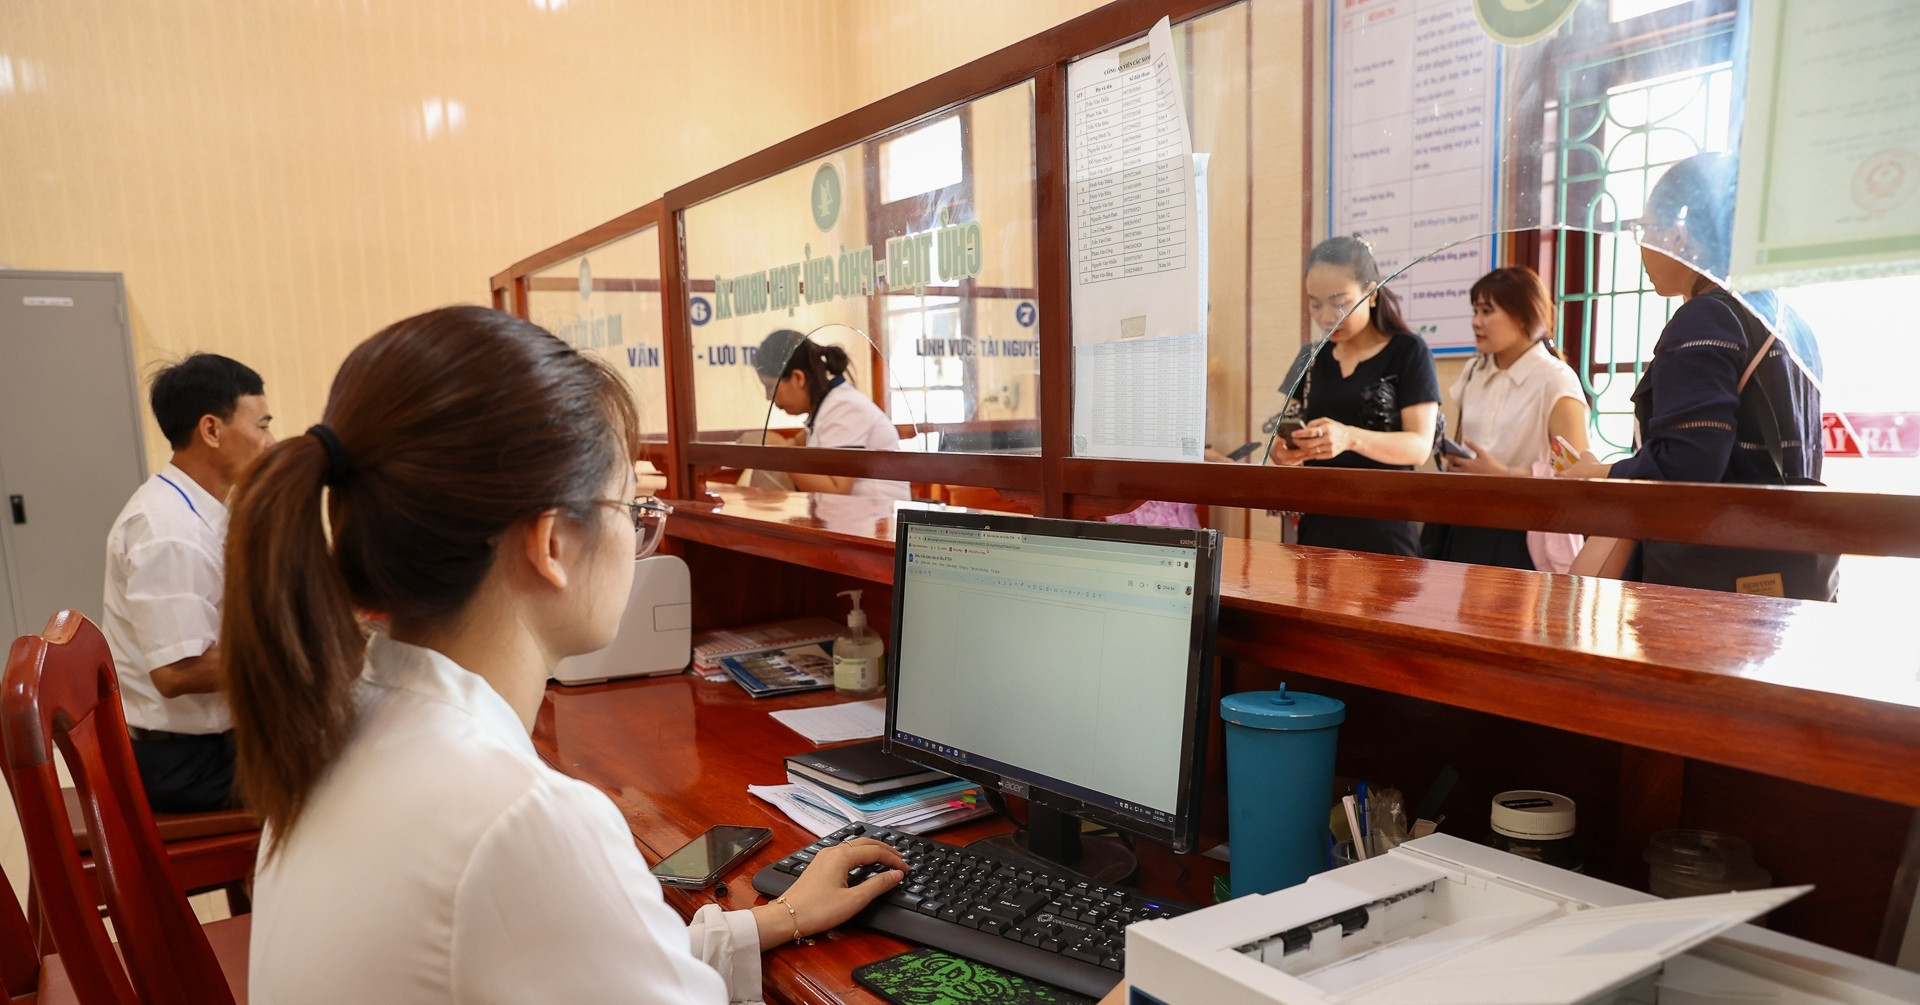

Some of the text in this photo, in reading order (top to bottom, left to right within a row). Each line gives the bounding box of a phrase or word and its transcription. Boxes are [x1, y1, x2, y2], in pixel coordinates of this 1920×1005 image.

[1018, 307, 1034, 323] 7
[626, 341, 659, 368] VĂN
[980, 335, 999, 357] TÀI
[1002, 338, 1040, 357] NGUYÊ
[1004, 781, 1024, 792] acer
